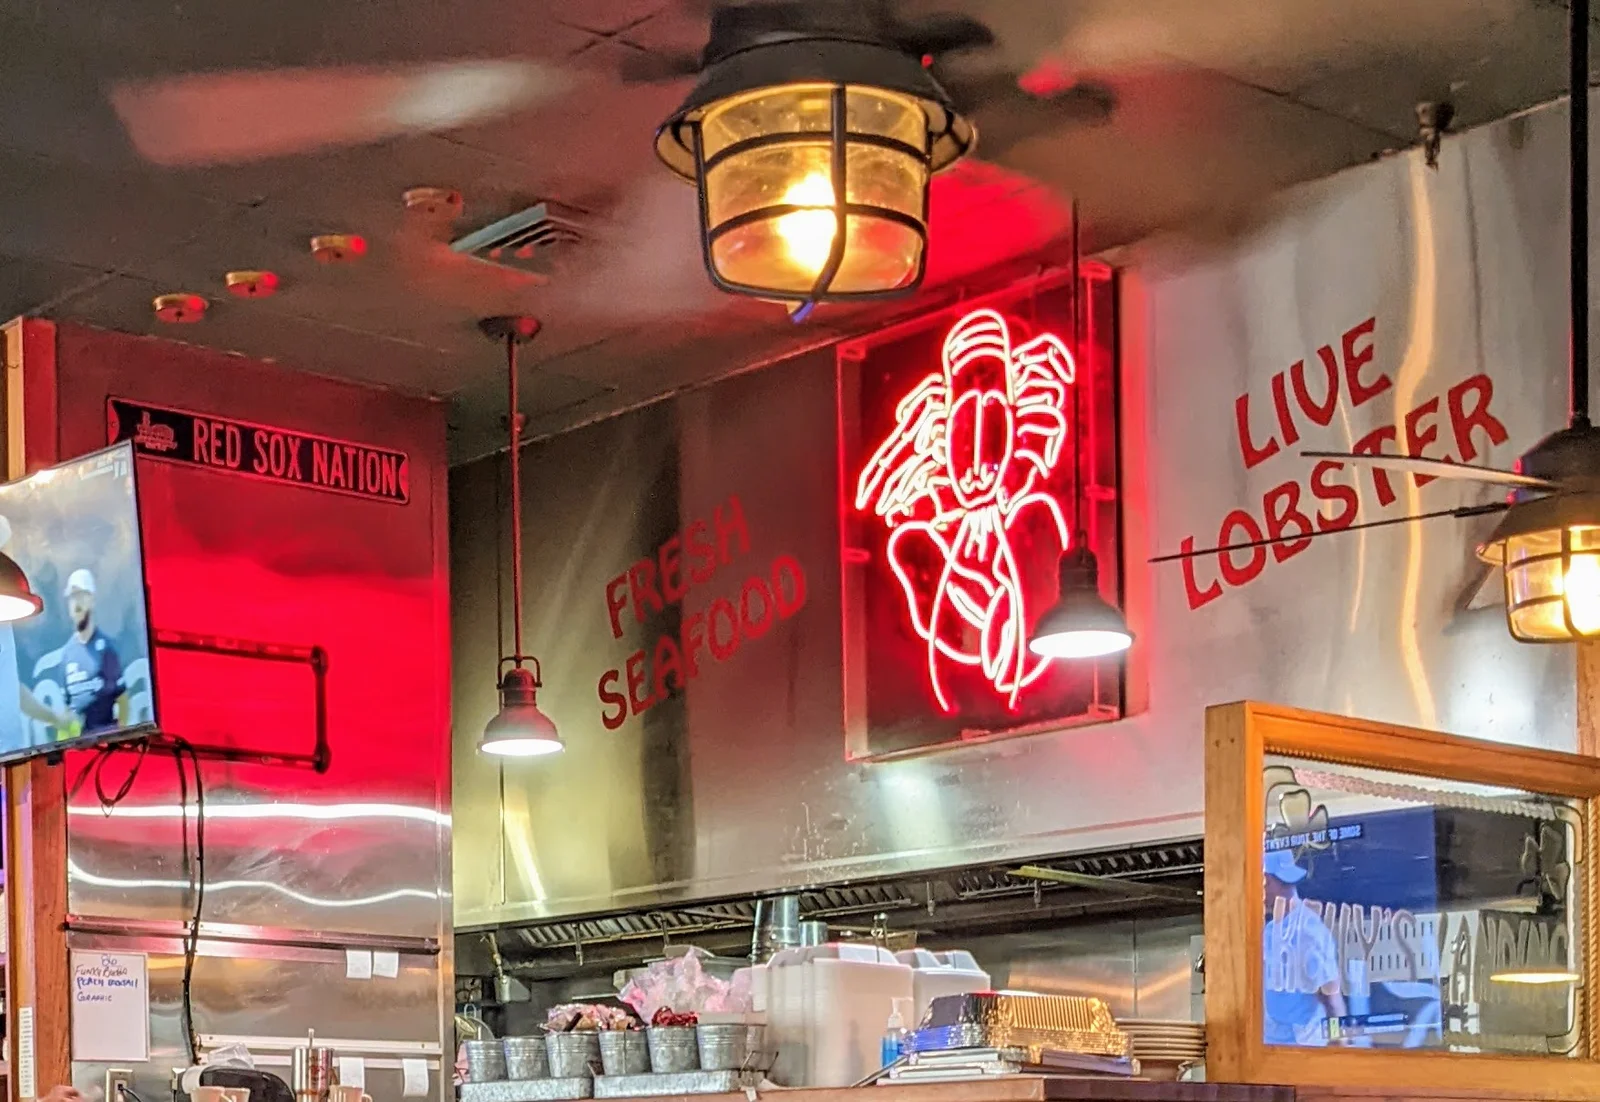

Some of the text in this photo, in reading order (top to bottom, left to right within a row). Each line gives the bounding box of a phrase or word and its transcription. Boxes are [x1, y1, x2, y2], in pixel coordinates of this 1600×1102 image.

[193, 418, 397, 496] RED SOX NATION
[1236, 317, 1392, 469] LIVE
[606, 495, 750, 639] FRESH
[1181, 374, 1509, 610] LOBSTER
[598, 555, 806, 730] SEAFOOD
